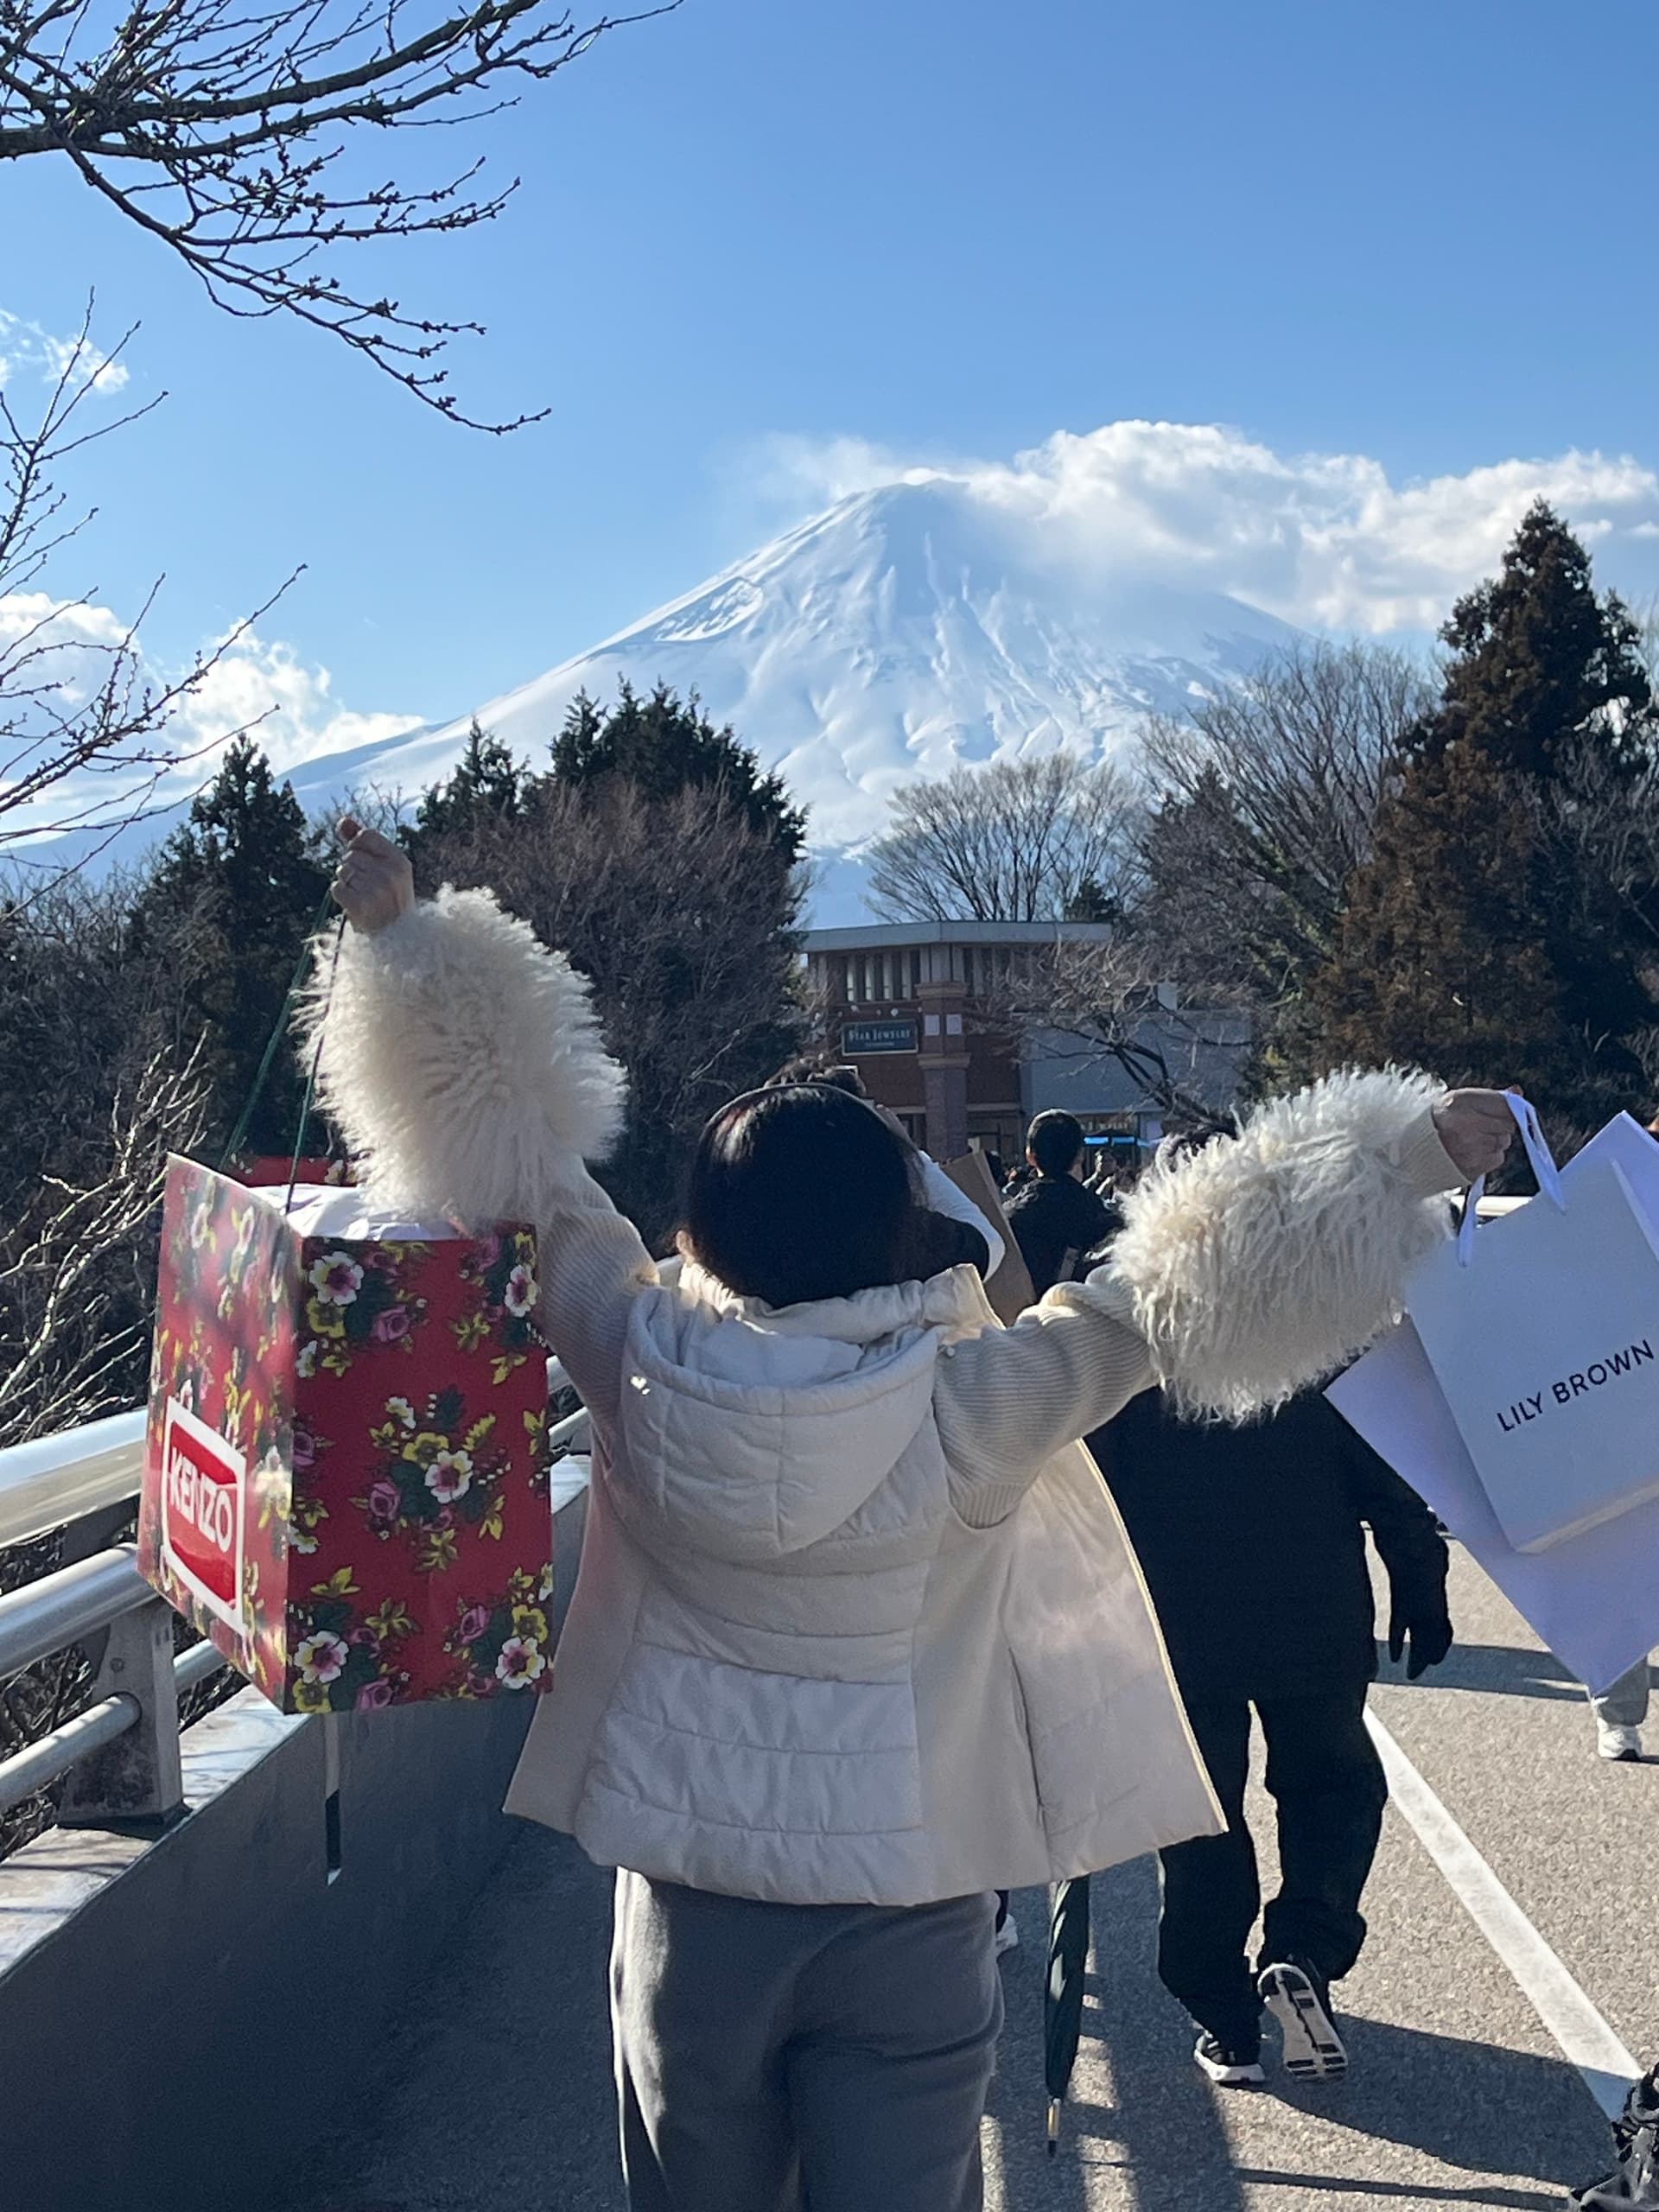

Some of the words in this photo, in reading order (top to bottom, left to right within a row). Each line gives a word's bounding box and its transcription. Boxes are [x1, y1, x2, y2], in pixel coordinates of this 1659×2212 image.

[1497, 1392, 1543, 1432] LILY
[1551, 1339, 1655, 1404] BROWN
[168, 1447, 232, 1552] KENZO
